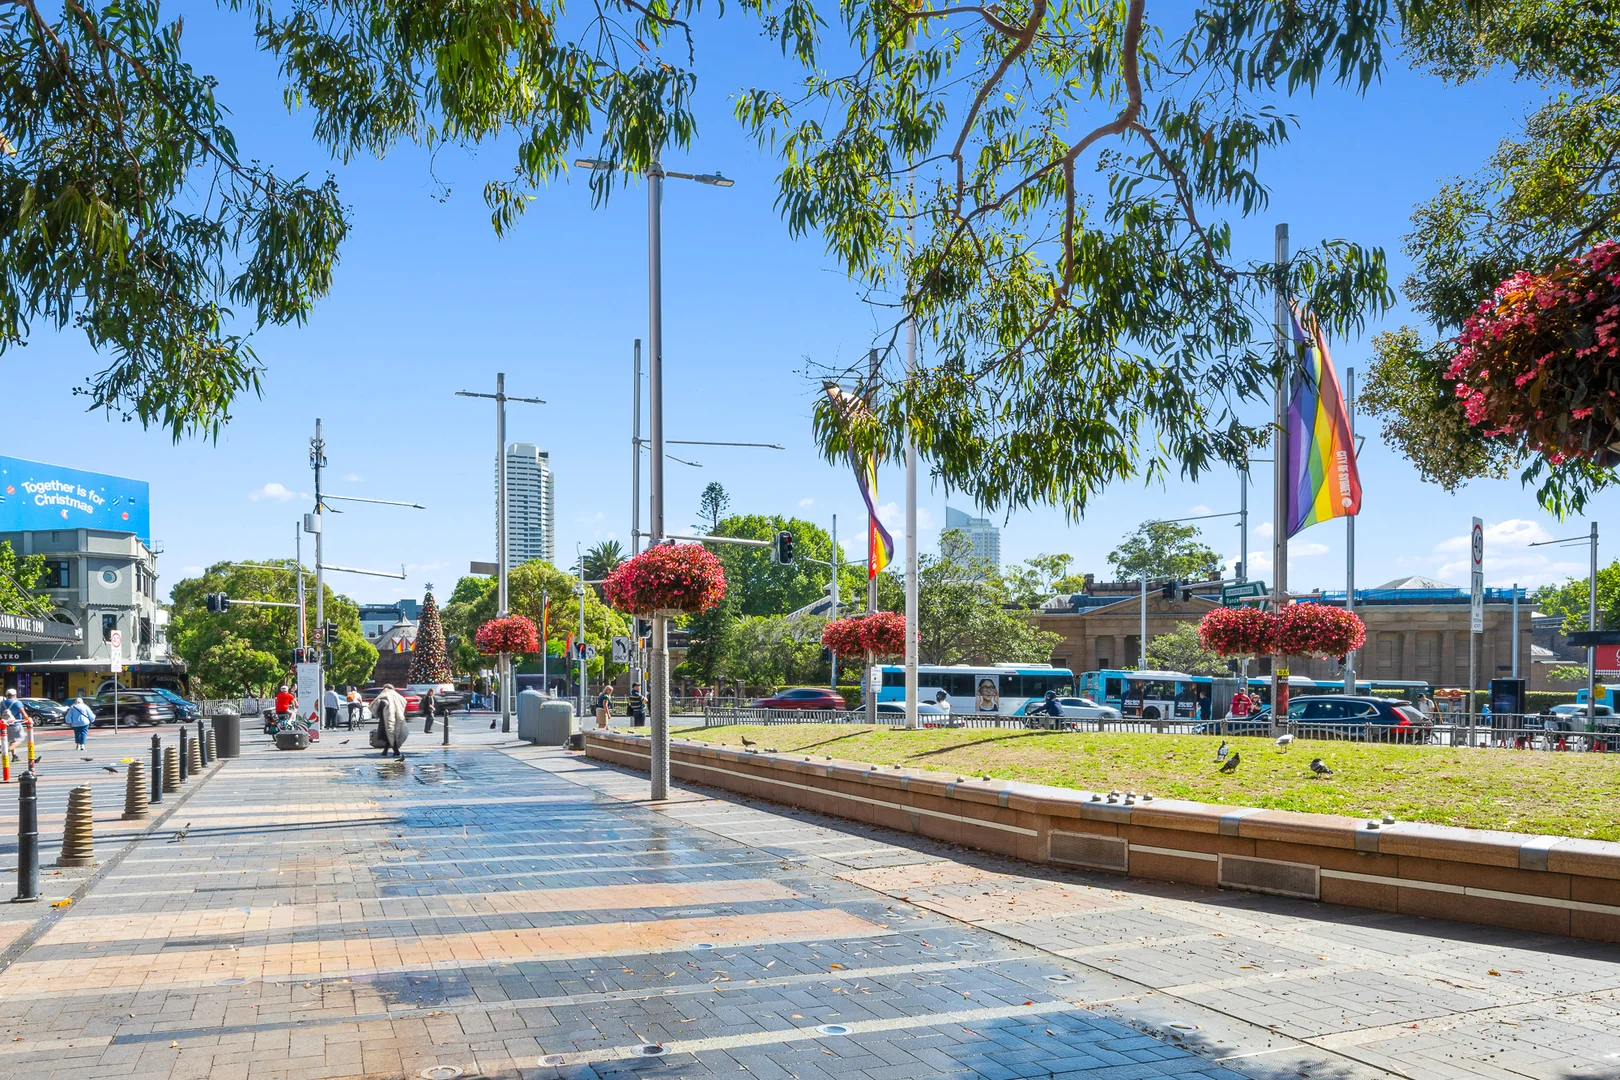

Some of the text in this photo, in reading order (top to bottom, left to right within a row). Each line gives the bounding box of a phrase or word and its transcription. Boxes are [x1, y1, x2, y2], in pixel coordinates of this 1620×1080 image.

[1336, 450, 1351, 497] CITY OF SYDNEY
[21, 480, 106, 506] Together is for
[34, 493, 94, 515] Christmas
[1474, 535, 1482, 554] 40
[16, 617, 31, 632] SINCE
